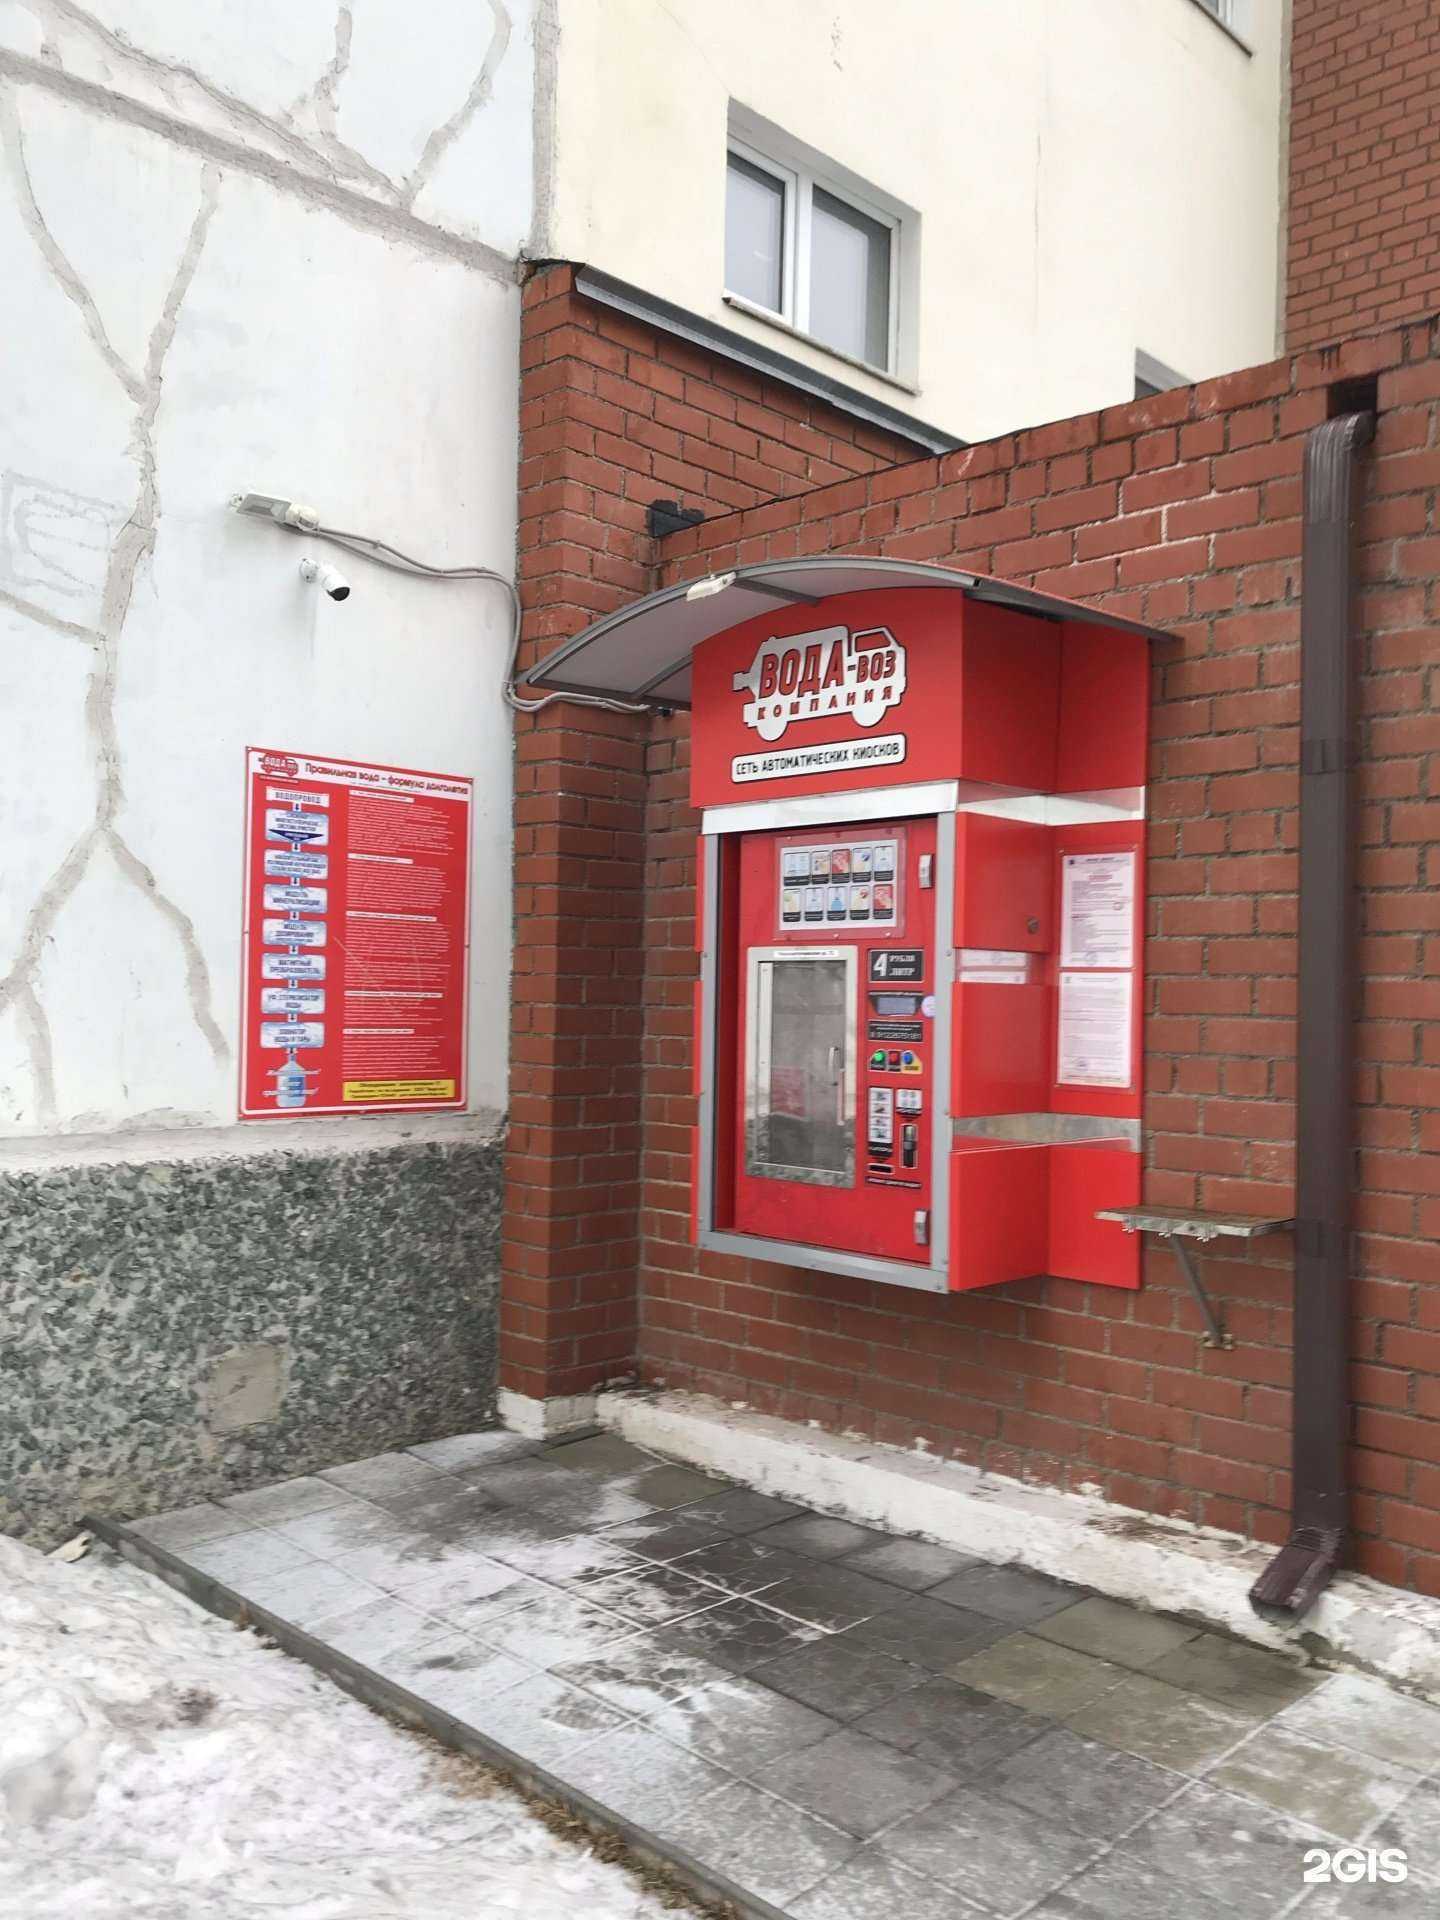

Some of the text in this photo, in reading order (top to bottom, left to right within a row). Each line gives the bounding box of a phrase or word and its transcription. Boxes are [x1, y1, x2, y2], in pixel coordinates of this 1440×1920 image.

[757, 686, 893, 720] КОМПАНИЯ
[305, 763, 357, 779] Правильная
[736, 742, 900, 775] СЕТЬ АВТОМАТИЧЕСКИХ КИОСКОВ
[873, 953, 888, 977] 4
